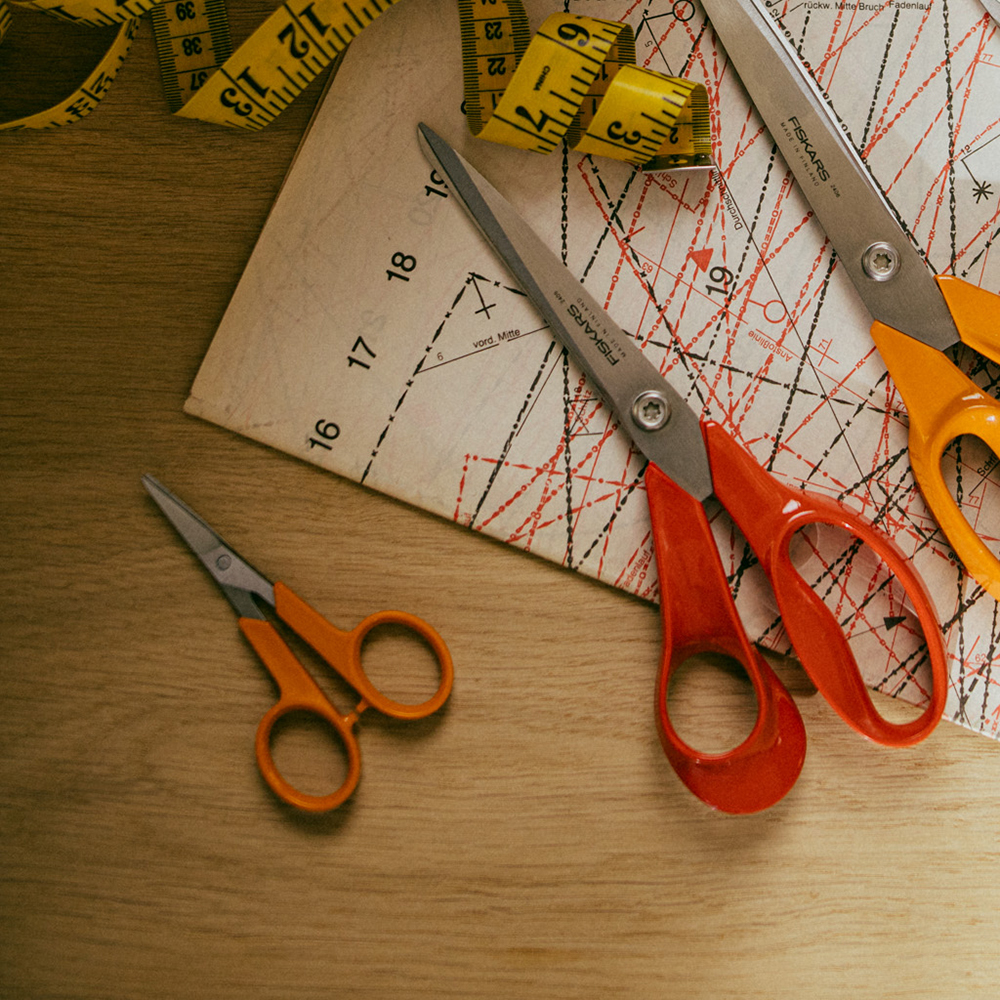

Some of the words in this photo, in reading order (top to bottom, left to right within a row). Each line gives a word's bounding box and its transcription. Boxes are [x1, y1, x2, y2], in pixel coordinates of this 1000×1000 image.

[175, 1, 195, 21] 39
[804, 1, 833, 11] rückw.
[834, 2, 856, 11] Mitte
[858, 2, 885, 12] Bruch
[889, 1, 933, 11] Fadenlauf
[277, 2, 331, 59] 12
[484, 21, 503, 40] 23
[557, 22, 591, 47] 6
[182, 36, 203, 56] 38
[487, 57, 506, 76] 22
[533, 65, 551, 92] CHINA
[220, 66, 270, 117] 13
[515, 105, 550, 132] 7
[607, 121, 643, 145] 3
[780, 122, 795, 143] MADE
[793, 145, 800, 153] IN
[799, 155, 820, 187] FINLAND
[787, 116, 831, 182] FISKARS
[711, 169, 743, 231] Durchschnittlin
[386, 251, 417, 283] 18
[705, 266, 734, 297] 19
[576, 297, 601, 328] FINLAND
[472, 336, 497, 348] vord.
[497, 328, 521, 341] Mitte
[566, 304, 620, 366] FISKARS
[602, 328, 610, 337] IN
[748, 330, 793, 362] Anstoßlinie
[347, 335, 377, 370] 17
[436, 351, 444, 361] 6
[610, 339, 627, 358] MADE
[309, 418, 341, 452] 16
[976, 453, 1000, 476] Schli
